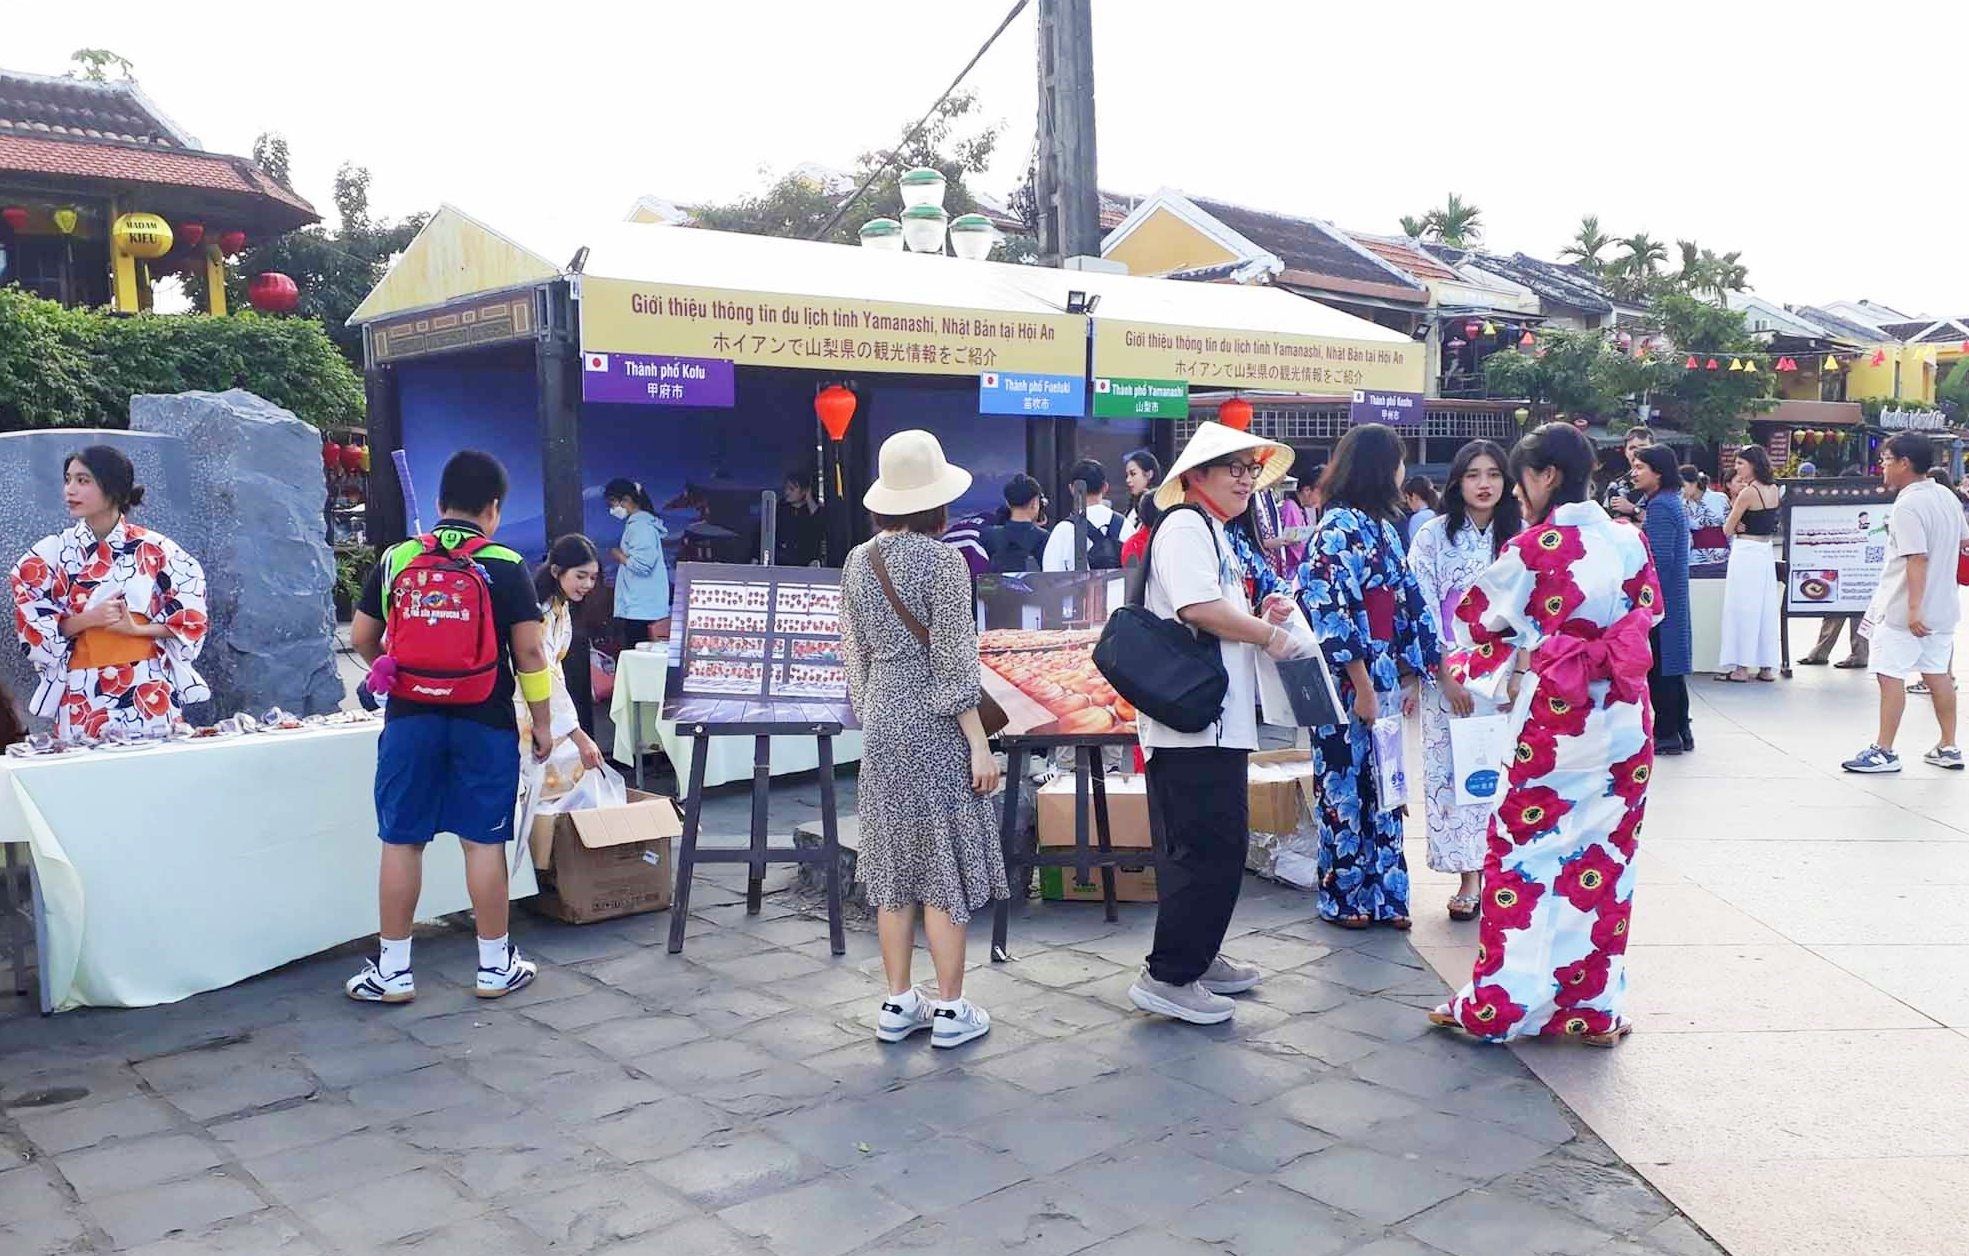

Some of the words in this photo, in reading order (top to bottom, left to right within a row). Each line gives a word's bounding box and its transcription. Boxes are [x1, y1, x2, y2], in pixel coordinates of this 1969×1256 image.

[126, 221, 157, 229] MADAM
[632, 293, 662, 315] Giới
[668, 297, 707, 321] thiệu
[712, 300, 754, 325] thông
[759, 304, 777, 323] tin
[782, 306, 799, 324] du
[804, 307, 829, 329] lịch
[833, 308, 858, 328] tỉnh
[863, 310, 938, 336] Yamanashi,
[942, 317, 970, 339] Nhật
[974, 319, 996, 337] Bản
[1000, 322, 1015, 342] tại
[1018, 322, 1037, 342] Hội
[1040, 323, 1055, 340] An
[713, 331, 997, 367] ホイアンで山梨県の観光情報をご紹介
[1125, 330, 1145, 347] Giới
[1148, 332, 1173, 351] thiệu
[1176, 334, 1203, 354] thông
[1206, 337, 1217, 352] tin
[1220, 338, 1232, 353] du
[1234, 338, 1251, 356] lịch
[1273, 341, 1323, 361] Yamanashi,
[1393, 350, 1404, 365] An
[625, 360, 658, 377] Thành
[660, 361, 680, 380] phố
[682, 363, 706, 379] Kofu
[1175, 360, 1364, 385] ホイアンで山梨県の観光情報をご紹介
[647, 382, 684, 399] 甲府市
[1005, 378, 1028, 392] Thành
[1029, 380, 1042, 394] phố
[1112, 383, 1133, 396] Thành
[1134, 381, 1147, 398] phố
[1147, 384, 1184, 397] Yamanashi
[1135, 401, 1159, 413] 山梨市
